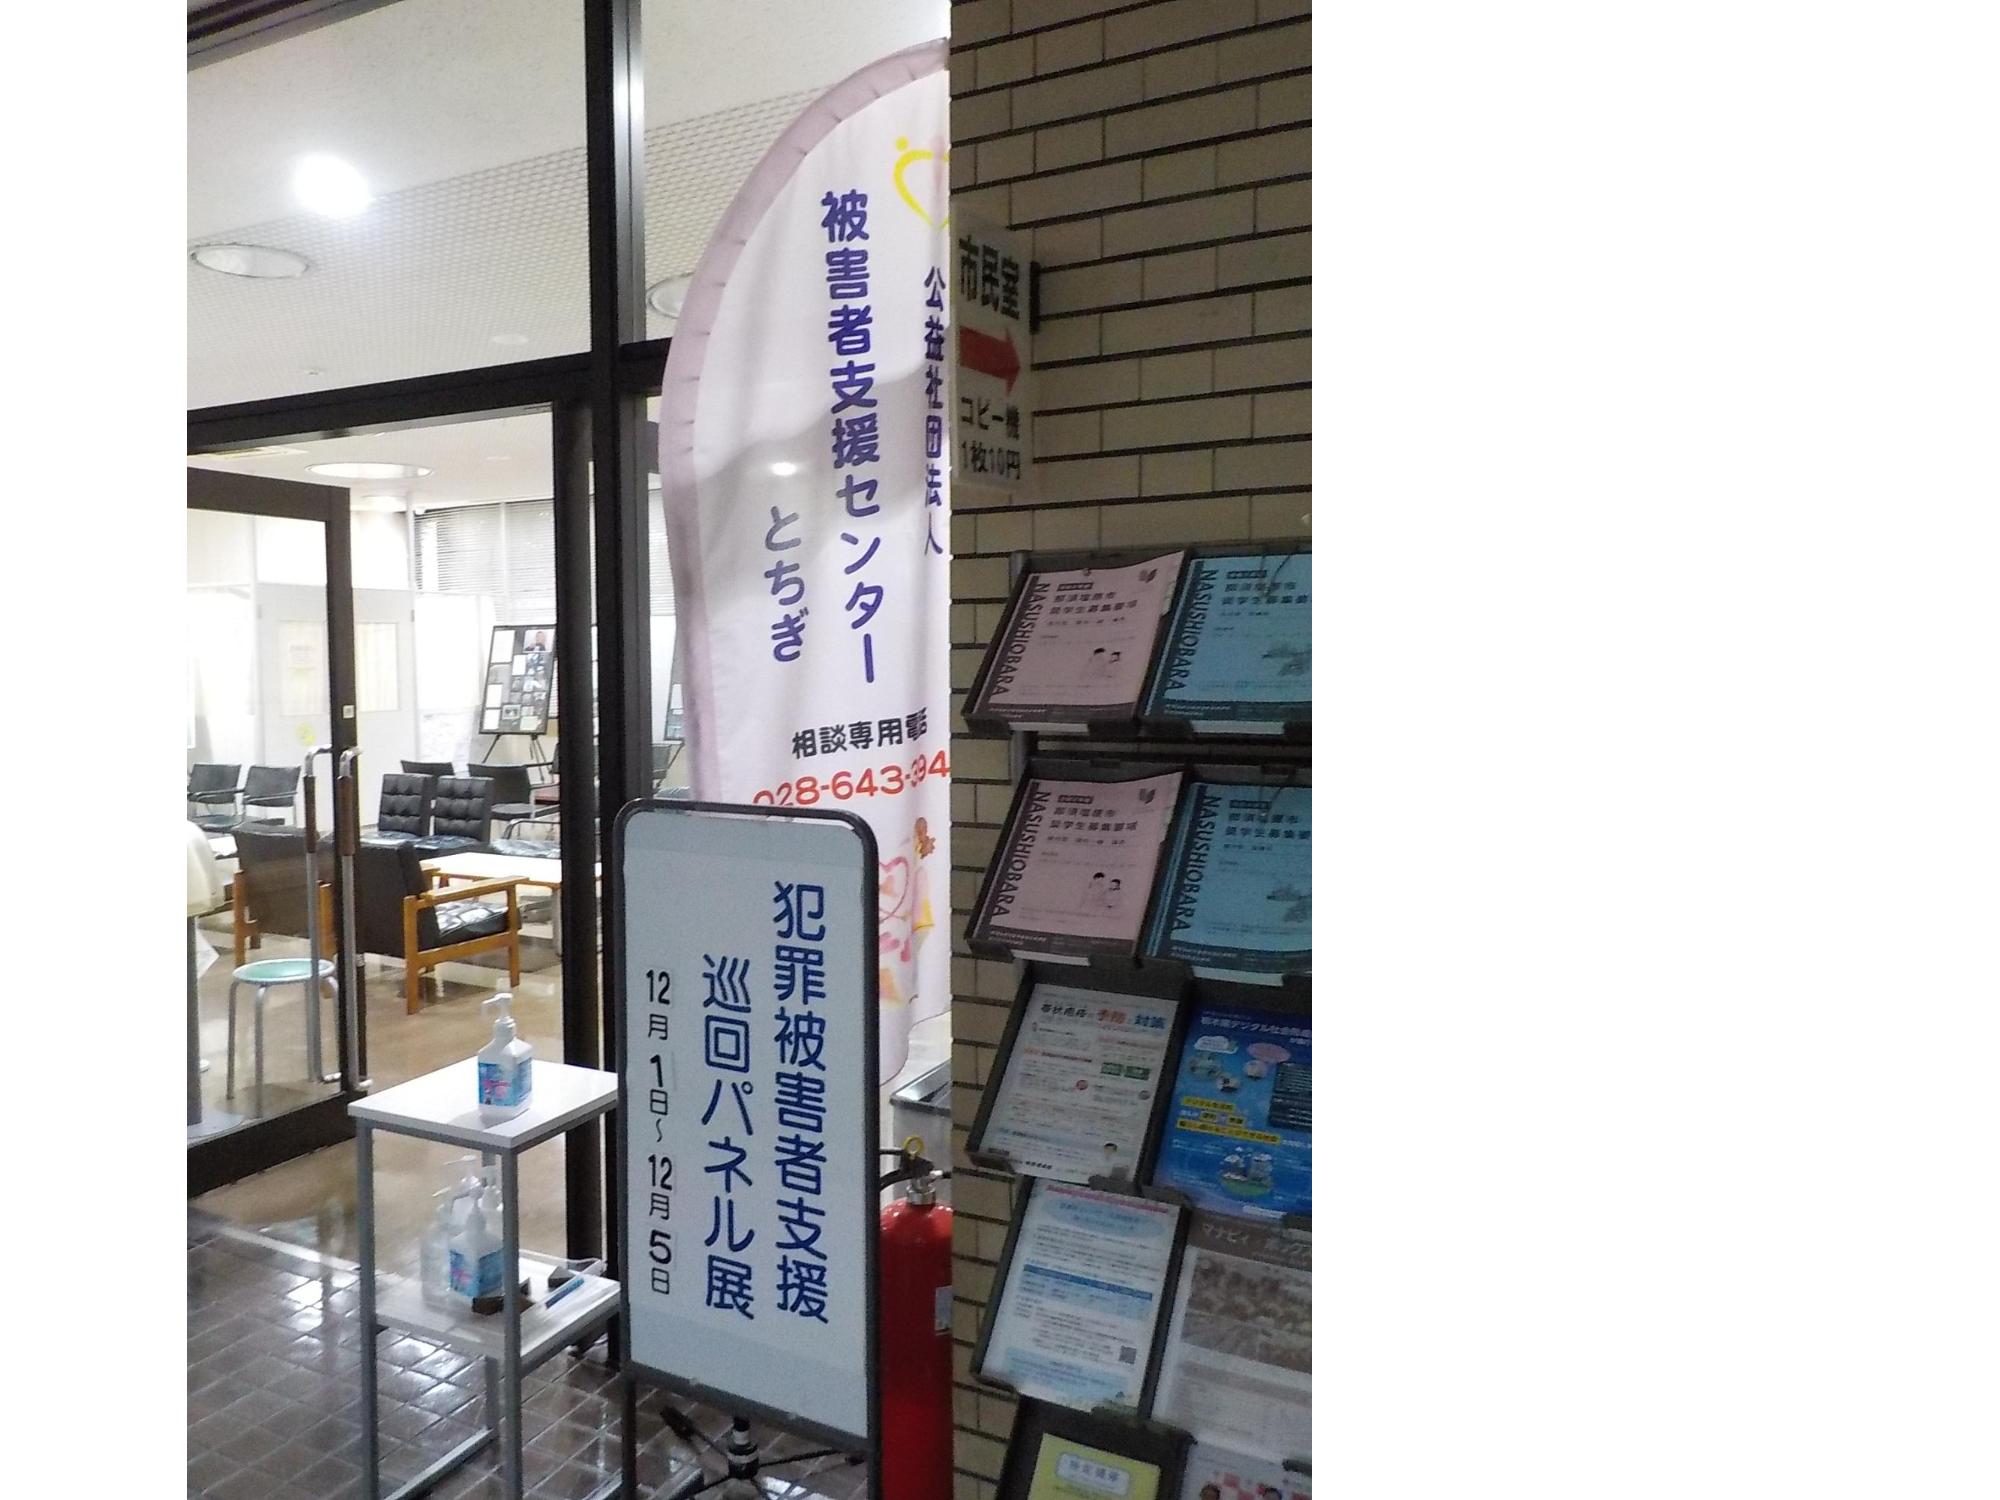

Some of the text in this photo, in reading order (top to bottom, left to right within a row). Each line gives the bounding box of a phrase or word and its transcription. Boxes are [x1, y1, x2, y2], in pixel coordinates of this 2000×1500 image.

[958, 234, 1020, 321] 市民室
[821, 189, 883, 683] 被害者支援センター
[922, 266, 945, 556] 公益社団法人
[763, 505, 809, 662] とちぎ
[991, 581, 1051, 696] NASUSHIOBARA
[1166, 568, 1220, 691] NASUSHIOBARA
[991, 790, 1051, 917] NASUSHIOBARA
[1171, 796, 1223, 931] NASUSHIOBARA
[701, 953, 755, 1321] 巡回パネル展
[772, 880, 829, 1324] 犯罪被害者支援
